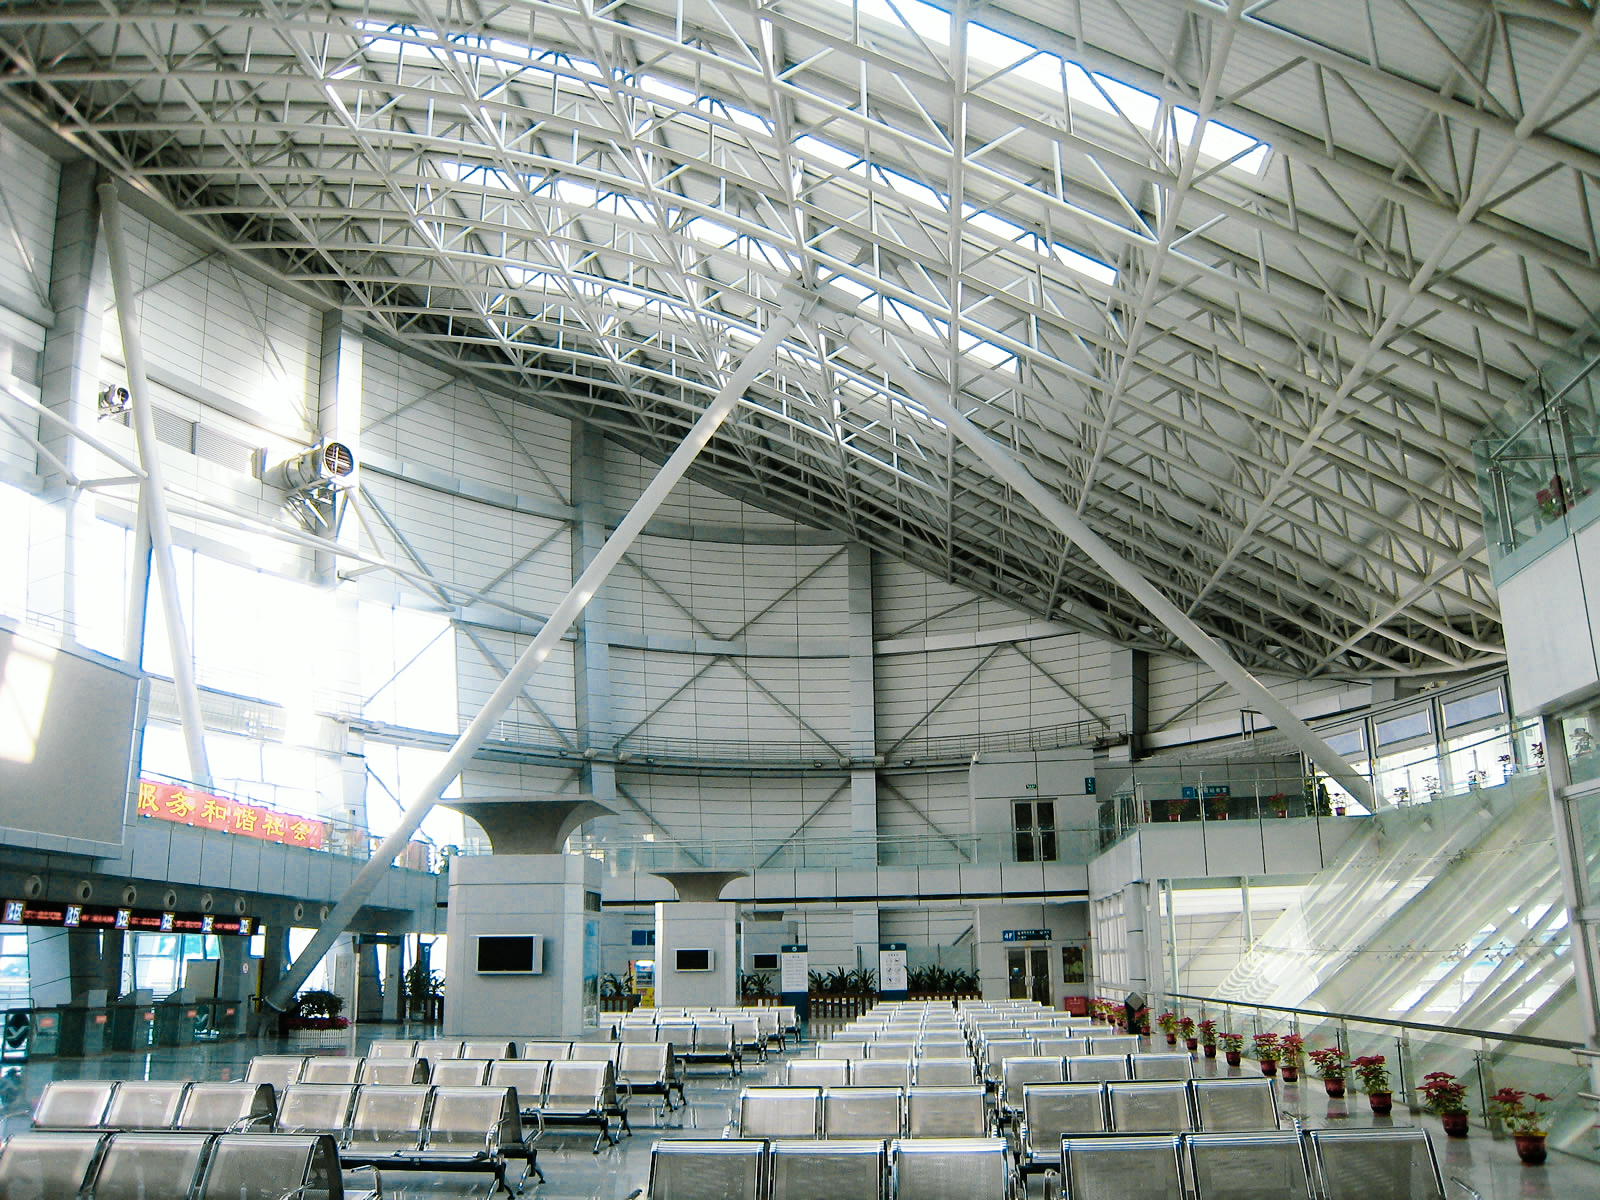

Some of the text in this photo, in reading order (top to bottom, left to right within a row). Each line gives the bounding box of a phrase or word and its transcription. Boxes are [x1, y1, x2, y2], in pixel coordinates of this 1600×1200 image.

[138, 783, 311, 841] 服务和谐社会
